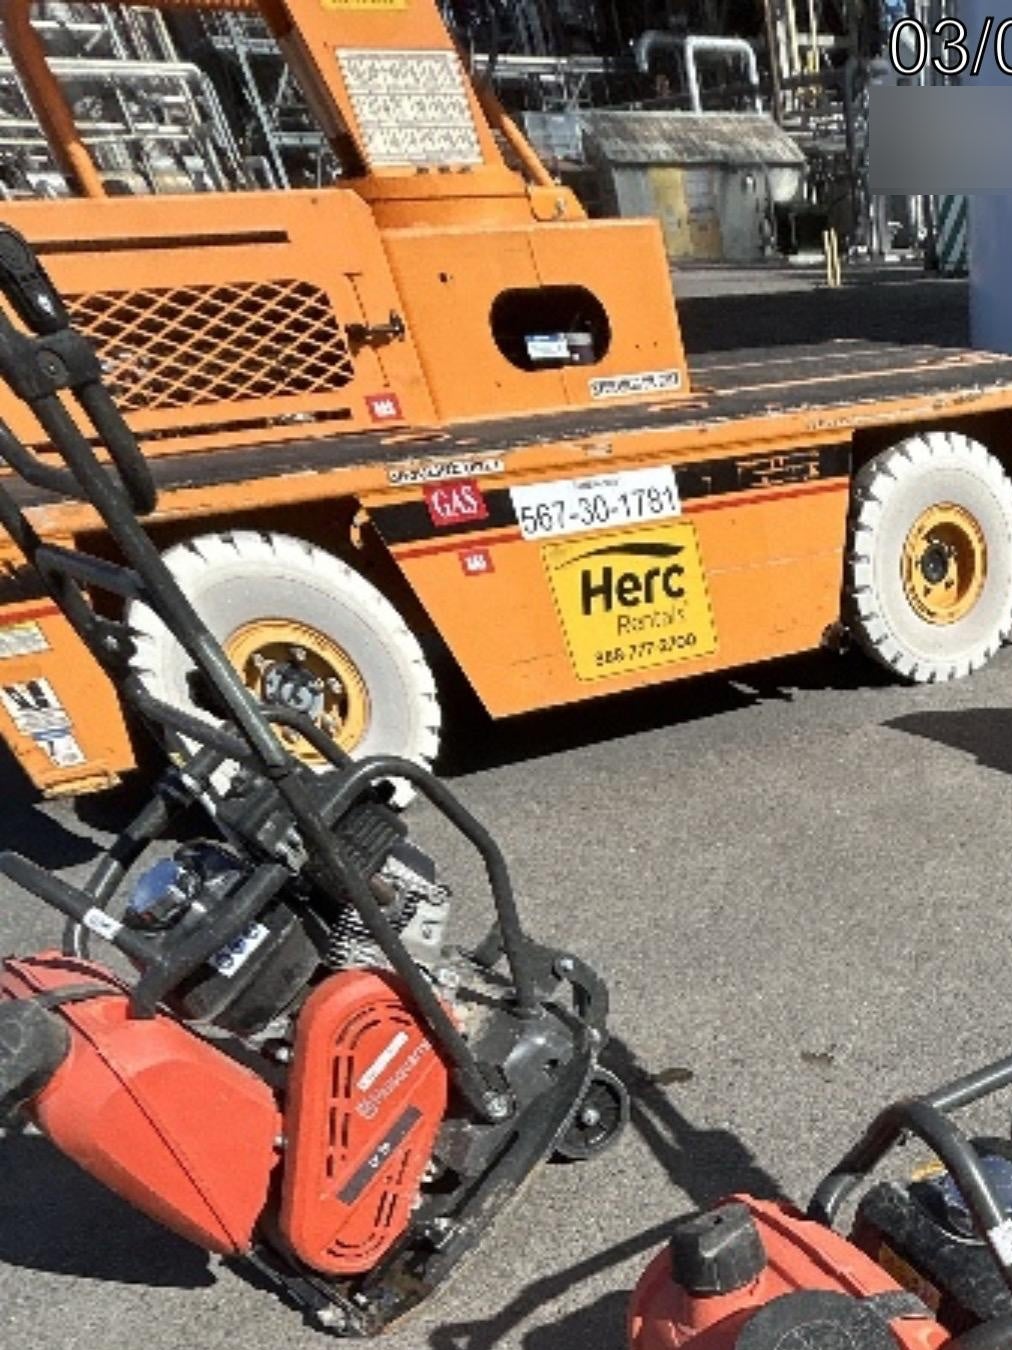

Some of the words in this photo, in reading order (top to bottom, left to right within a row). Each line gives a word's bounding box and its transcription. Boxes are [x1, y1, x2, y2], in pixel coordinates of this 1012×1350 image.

[431, 485, 478, 518] GAS
[521, 485, 677, 535] 567-30-1781
[581, 563, 685, 616] Herc
